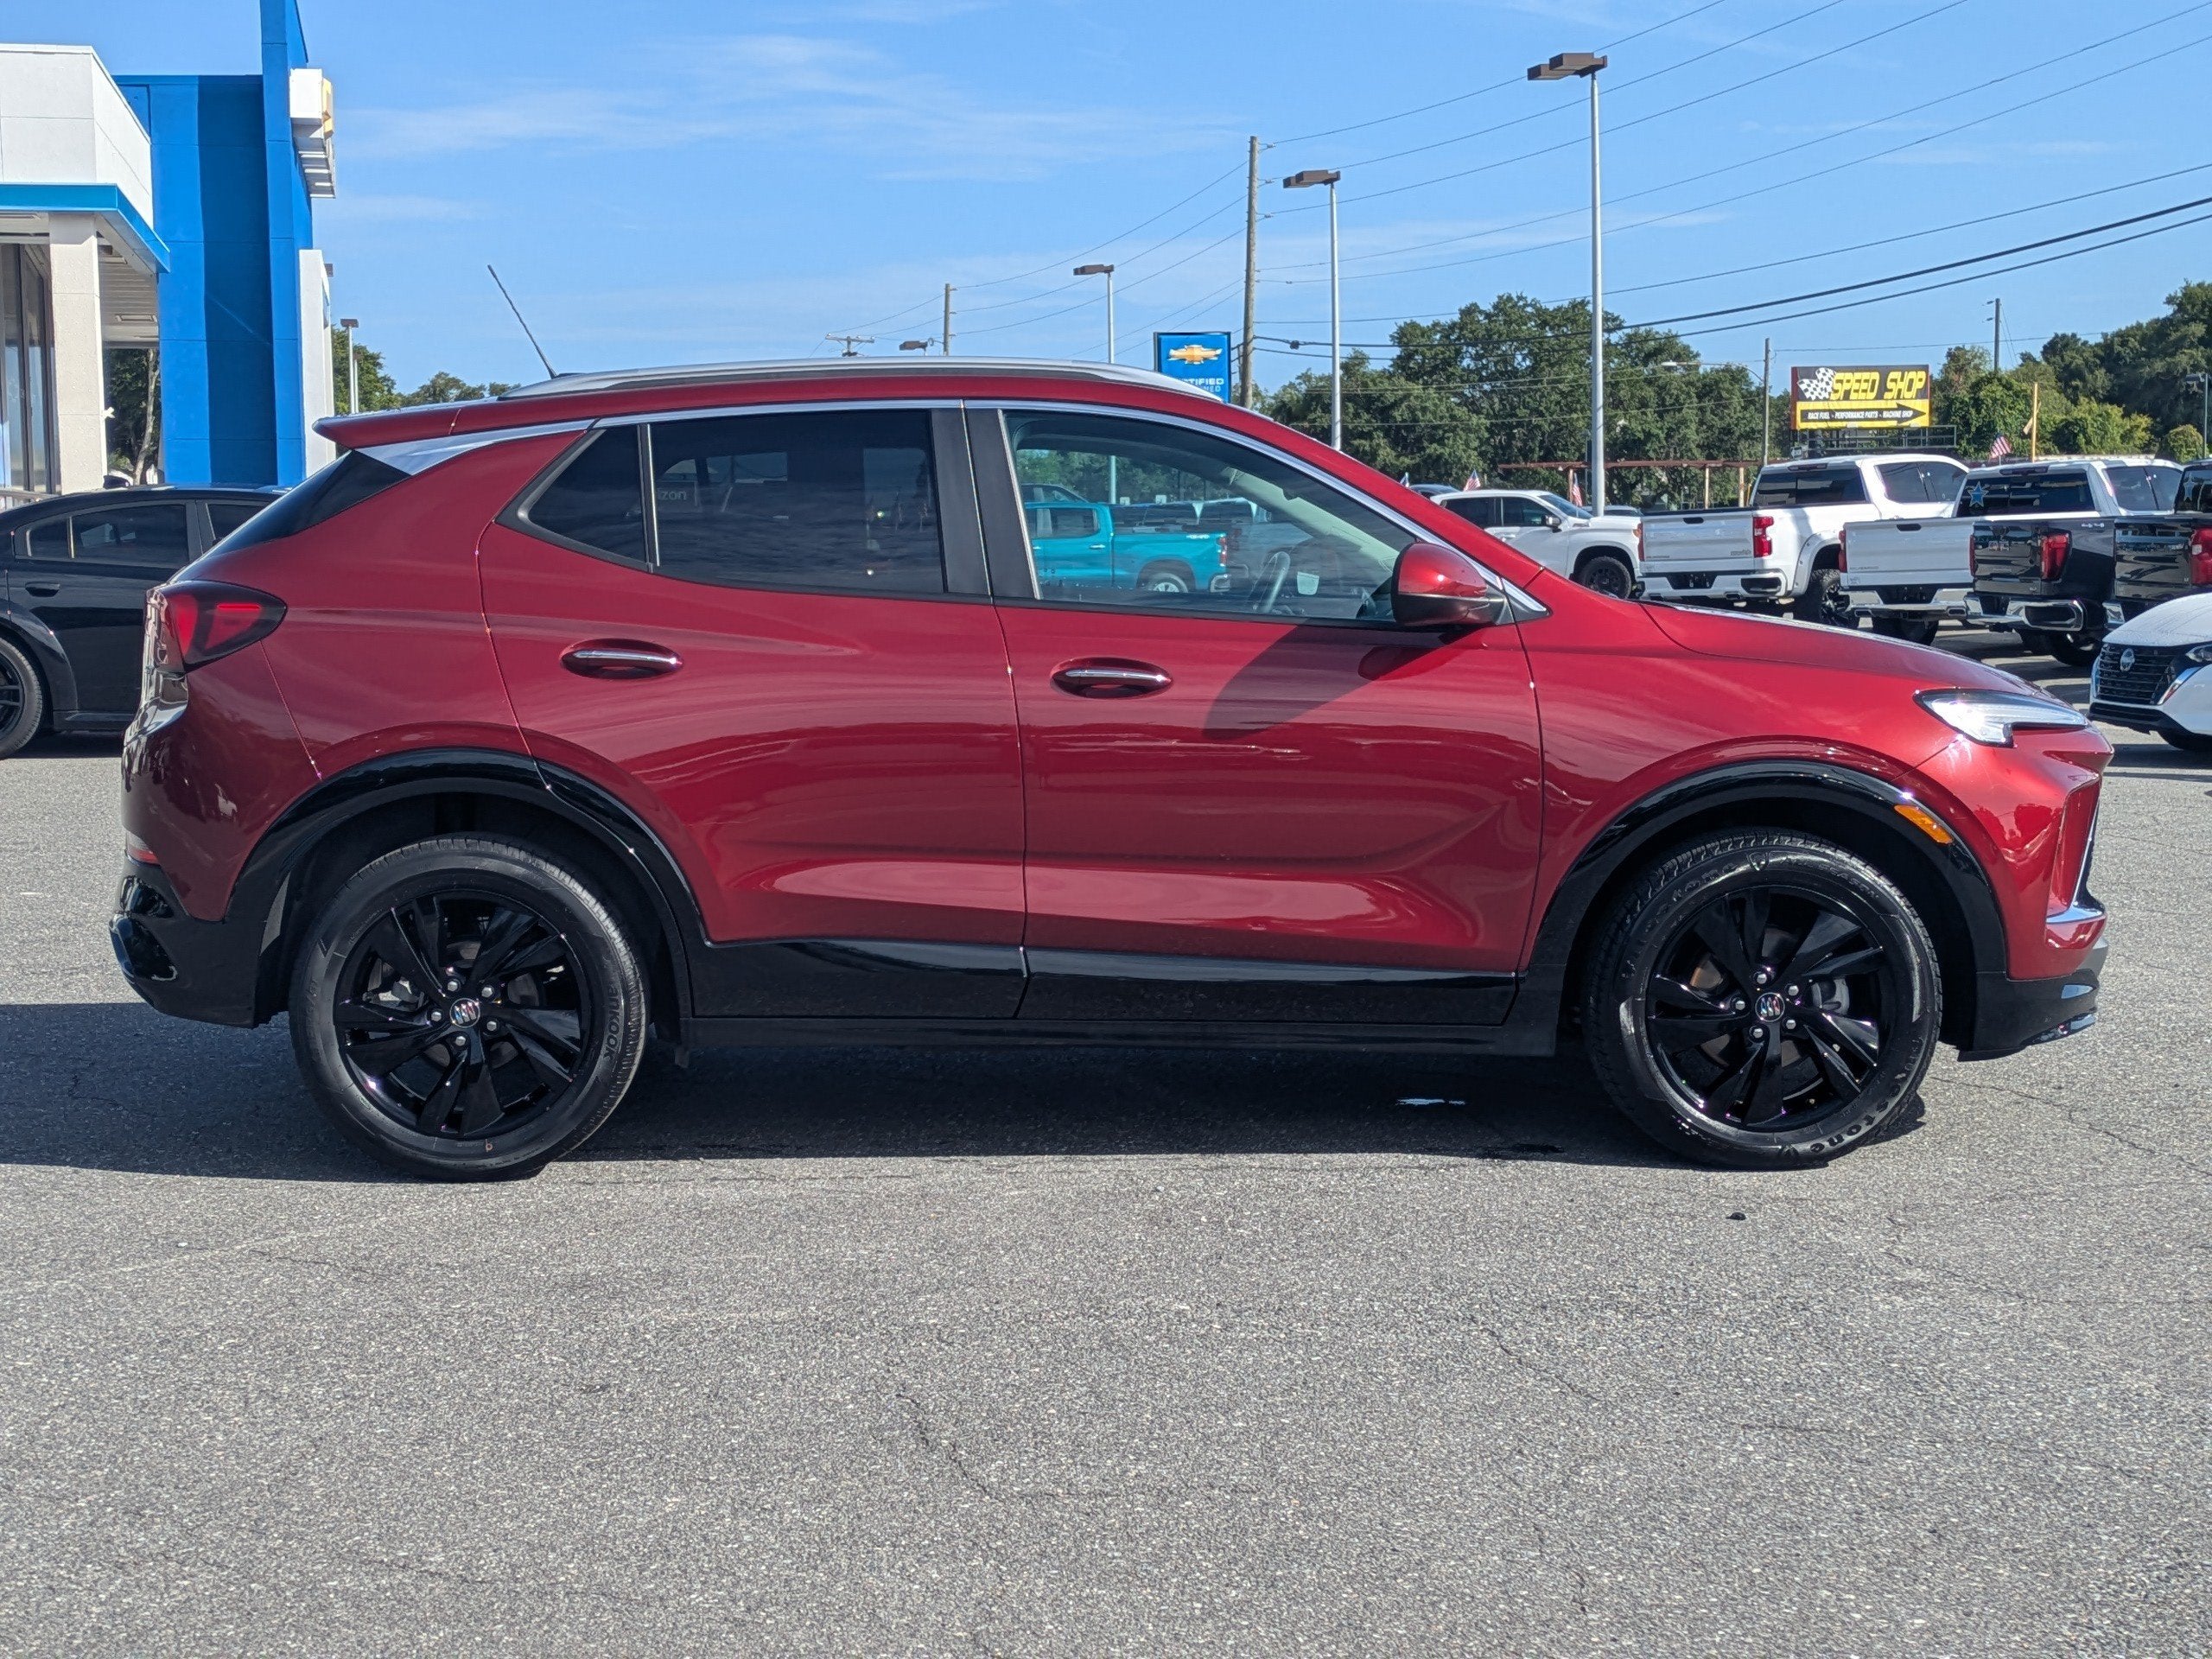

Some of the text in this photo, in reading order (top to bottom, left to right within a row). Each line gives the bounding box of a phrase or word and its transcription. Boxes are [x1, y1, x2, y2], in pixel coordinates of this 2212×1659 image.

[1829, 371, 1926, 400] SPEED SHOP
[602, 982, 621, 1060] ankook
